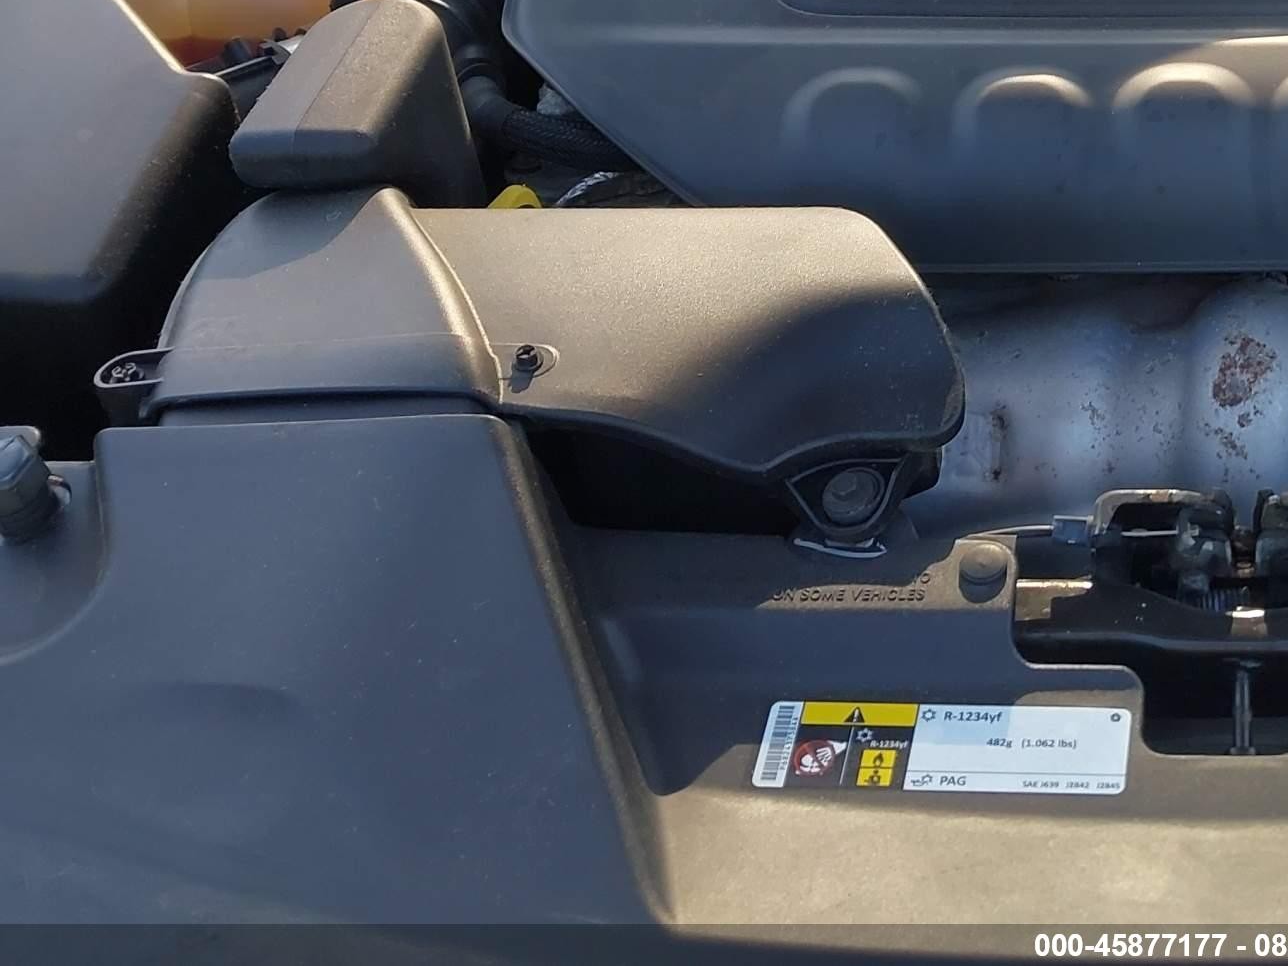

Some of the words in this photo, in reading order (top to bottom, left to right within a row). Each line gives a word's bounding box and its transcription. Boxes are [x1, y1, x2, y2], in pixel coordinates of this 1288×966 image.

[799, 588, 845, 602] SOME
[851, 588, 926, 602] VEHICLES
[943, 711, 1002, 724] R-1234yf
[986, 738, 1013, 749] 482g
[1021, 739, 1055, 750] (1.062
[1058, 739, 1077, 750] lbs)
[939, 776, 967, 786] PAG
